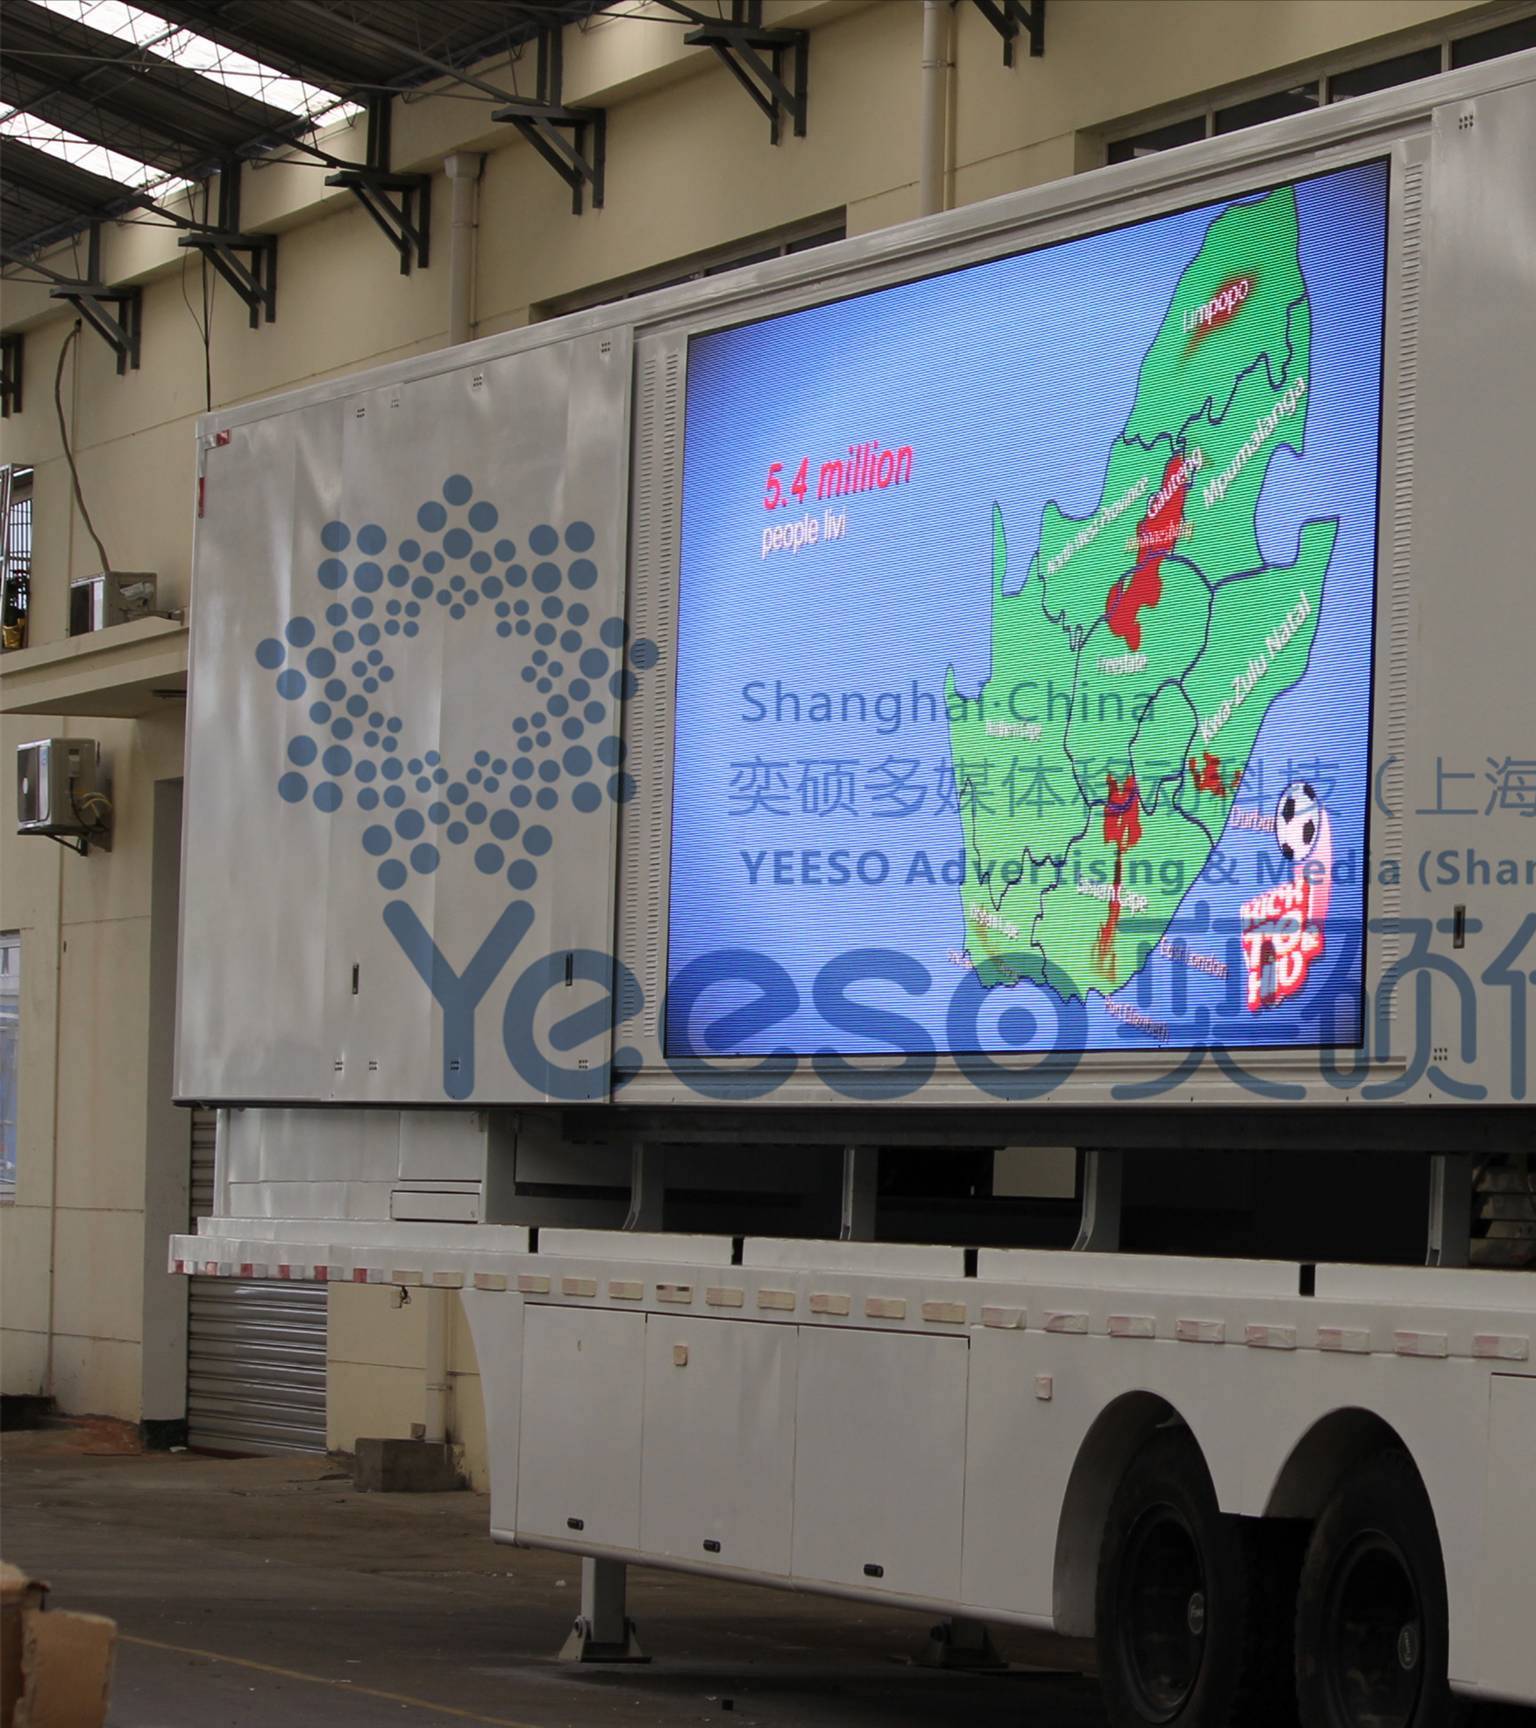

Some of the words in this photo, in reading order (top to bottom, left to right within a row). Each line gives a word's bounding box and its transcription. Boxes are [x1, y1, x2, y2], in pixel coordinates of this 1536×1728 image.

[1182, 279, 1249, 334] Limpopo
[763, 455, 809, 511] 5.4
[817, 438, 913, 501] million
[1202, 376, 1307, 511] Mpumalanga
[1146, 446, 1203, 519] Gauteng
[760, 511, 819, 560] people
[1264, 590, 1312, 660] Natal
